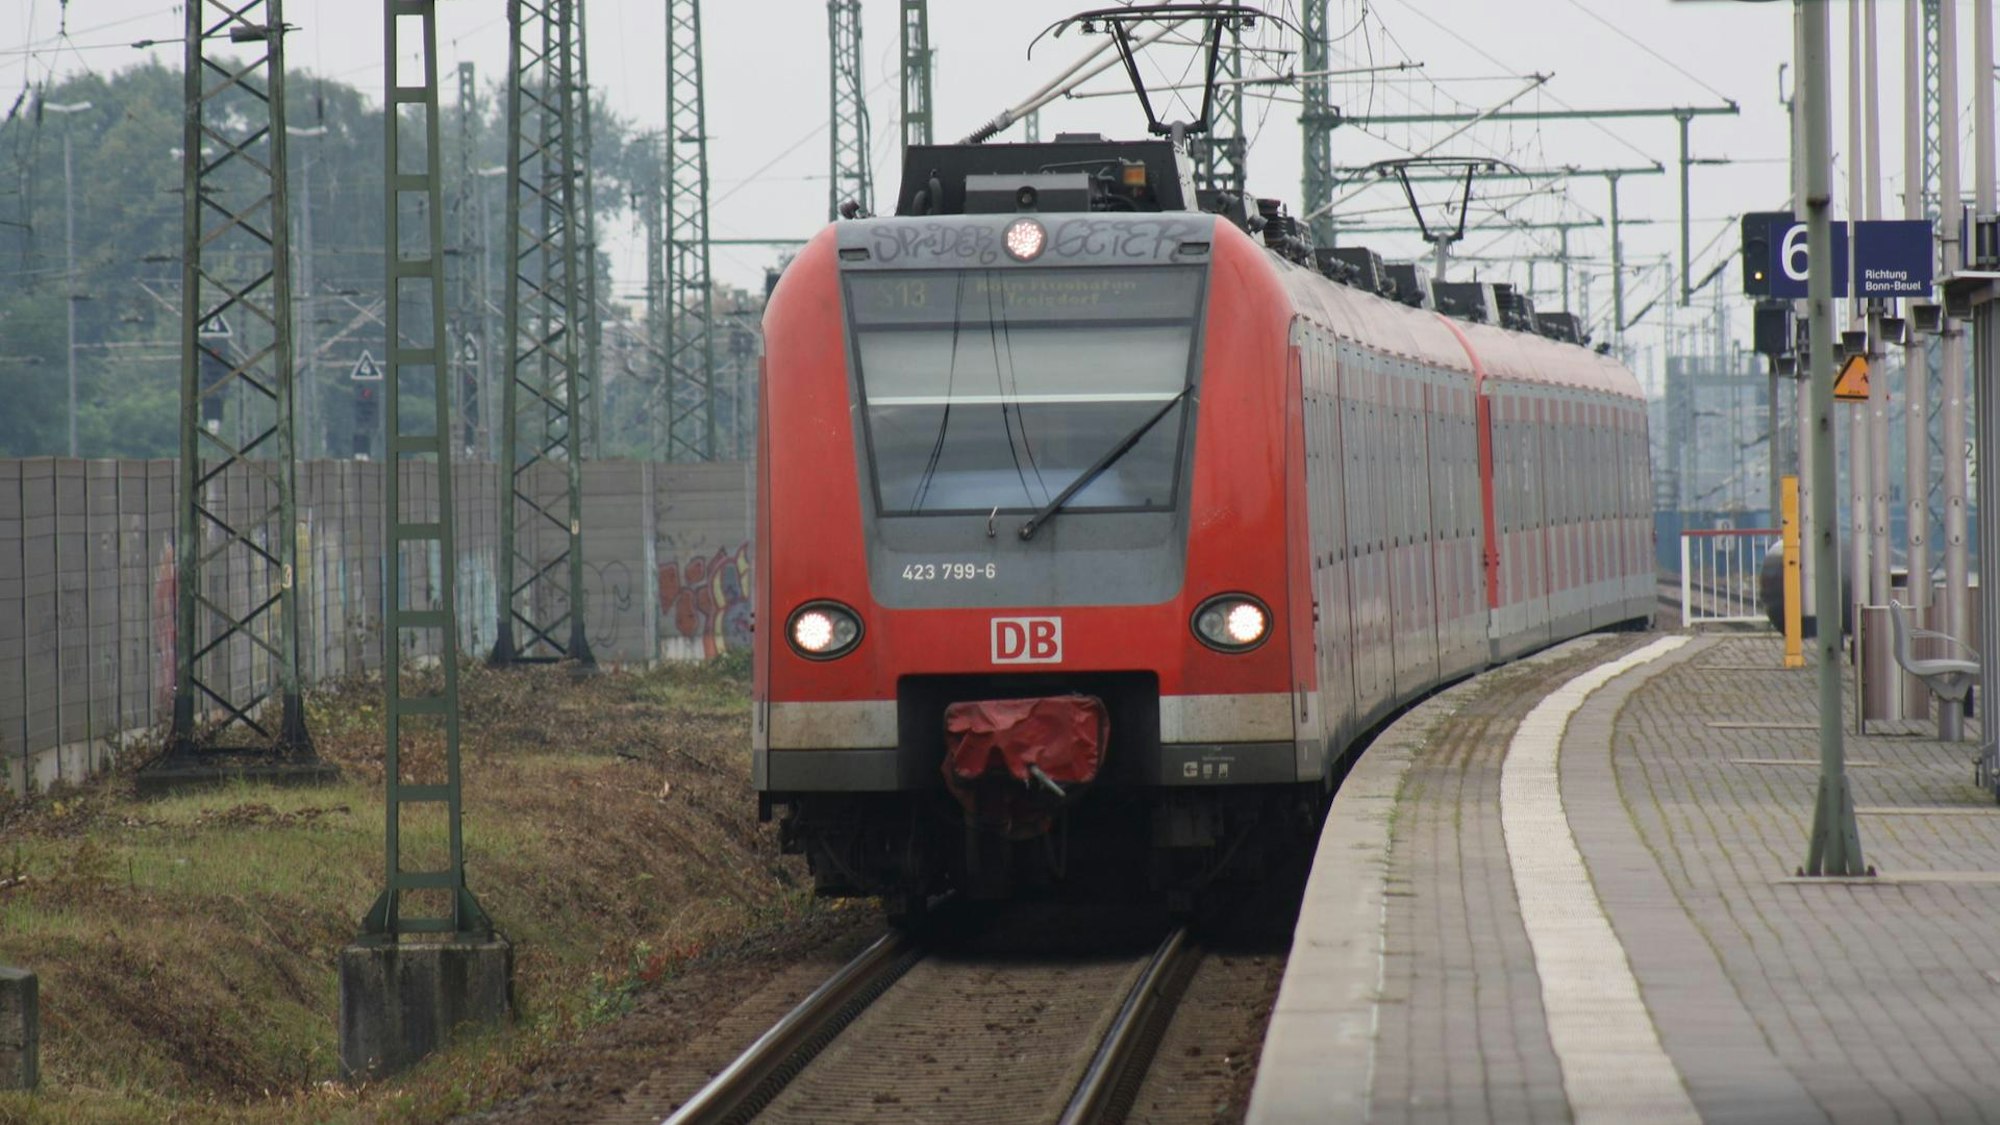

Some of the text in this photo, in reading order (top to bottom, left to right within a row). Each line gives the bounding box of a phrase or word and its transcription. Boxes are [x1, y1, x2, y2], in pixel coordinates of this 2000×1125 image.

[1781, 224, 1809, 281] 6
[1865, 269, 1907, 280] Richtung
[1865, 280, 1921, 291] Bonn-Beuel
[902, 563, 996, 580] 423 799-6
[995, 620, 1059, 660] DB
